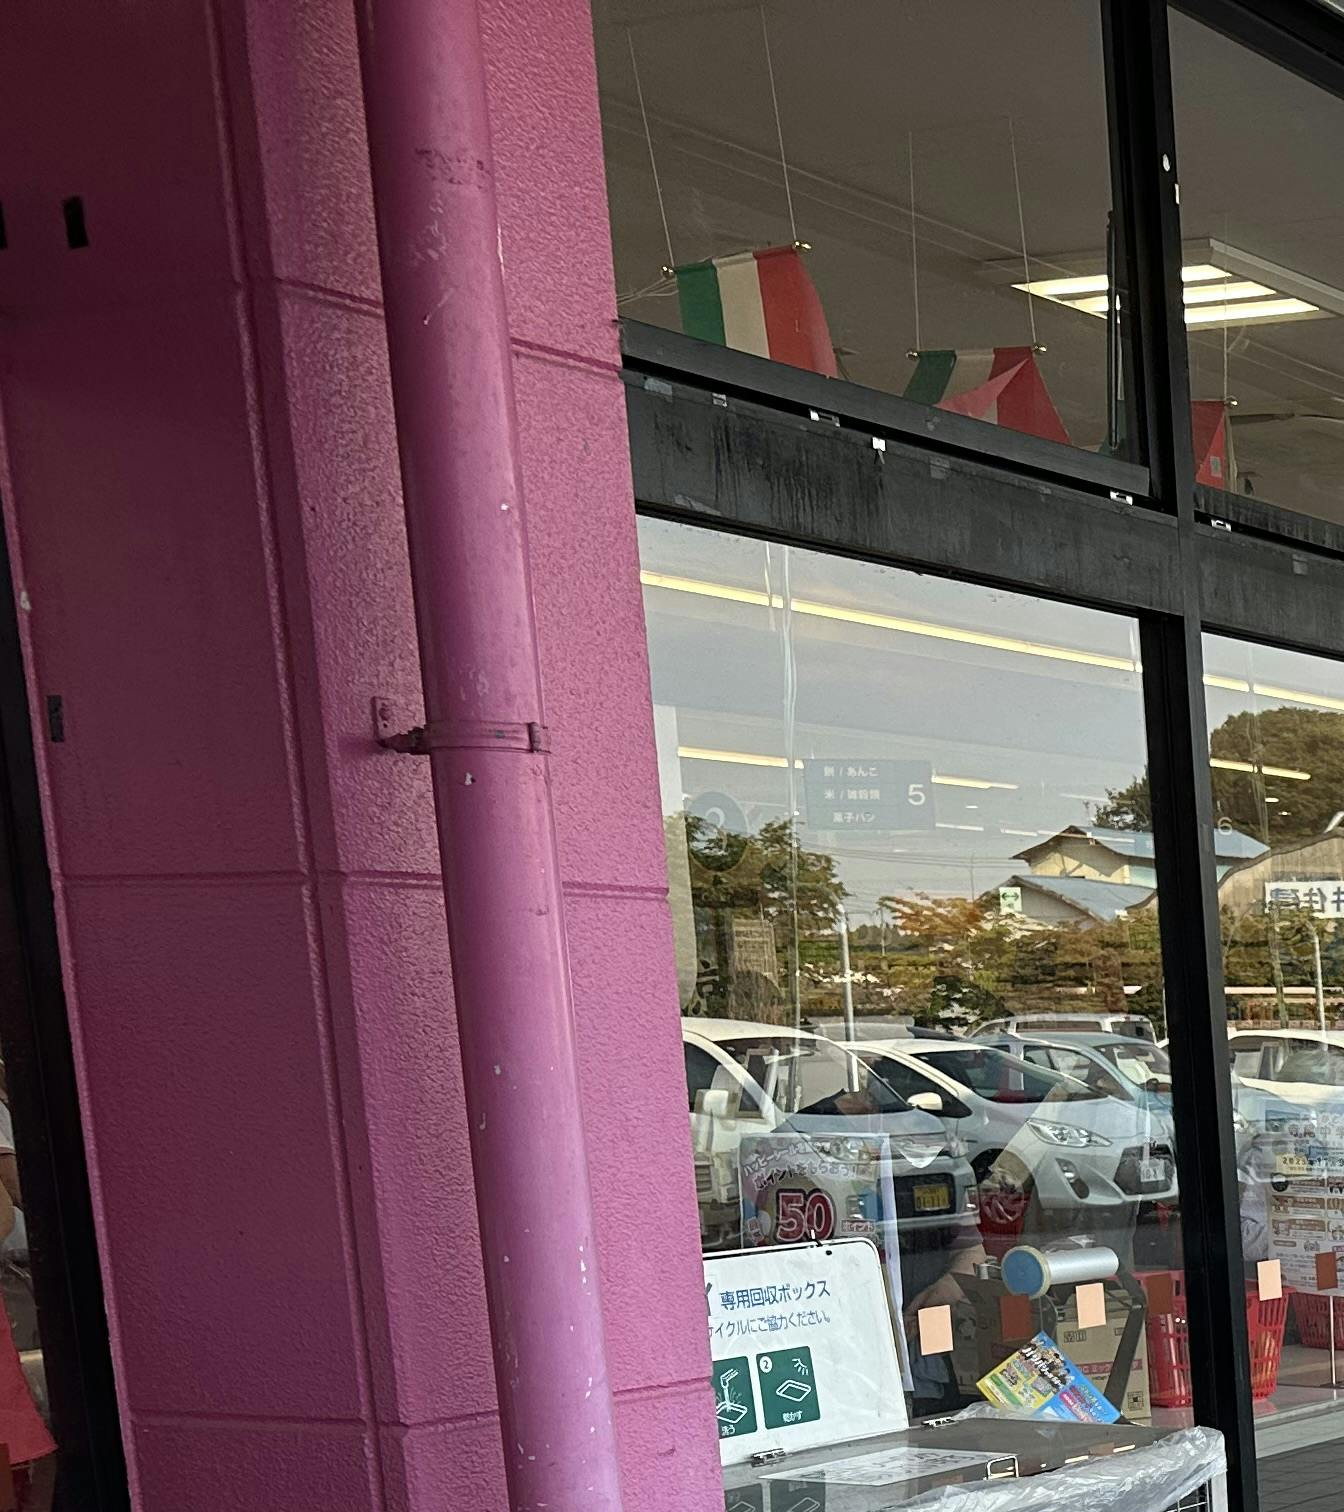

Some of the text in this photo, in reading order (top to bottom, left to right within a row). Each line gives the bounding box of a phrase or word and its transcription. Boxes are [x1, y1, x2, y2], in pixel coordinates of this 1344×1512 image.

[847, 766, 879, 777] あんこ
[823, 788, 835, 801] 米
[906, 783, 926, 806] 5
[1217, 816, 1233, 837] 6
[776, 1188, 835, 1243] 50
[719, 1280, 831, 1311] 専用回収ボックス
